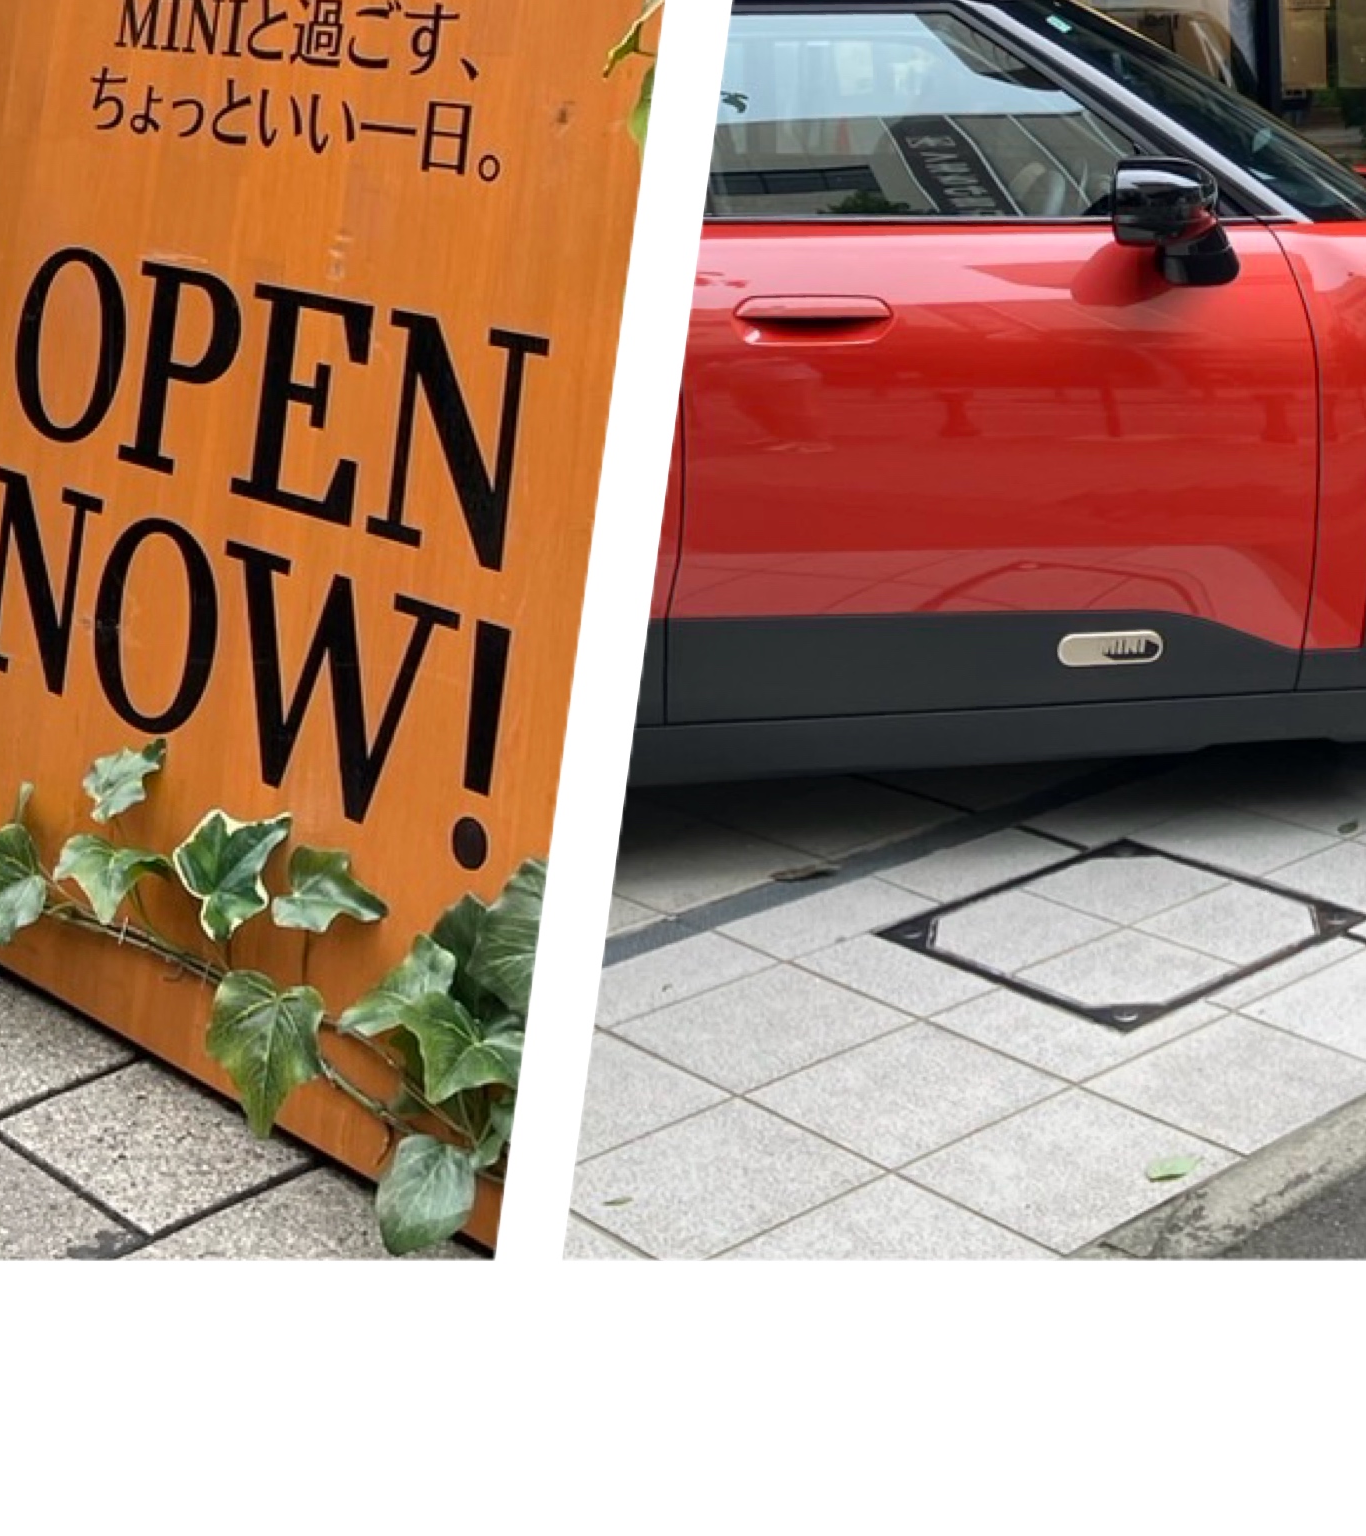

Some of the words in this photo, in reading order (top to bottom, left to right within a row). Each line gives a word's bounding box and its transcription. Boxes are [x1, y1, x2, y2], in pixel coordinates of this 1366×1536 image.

[90, 67, 501, 182] ちょっといい一日。
[15, 246, 550, 572] OPEN
[1102, 637, 1146, 655] MINI
